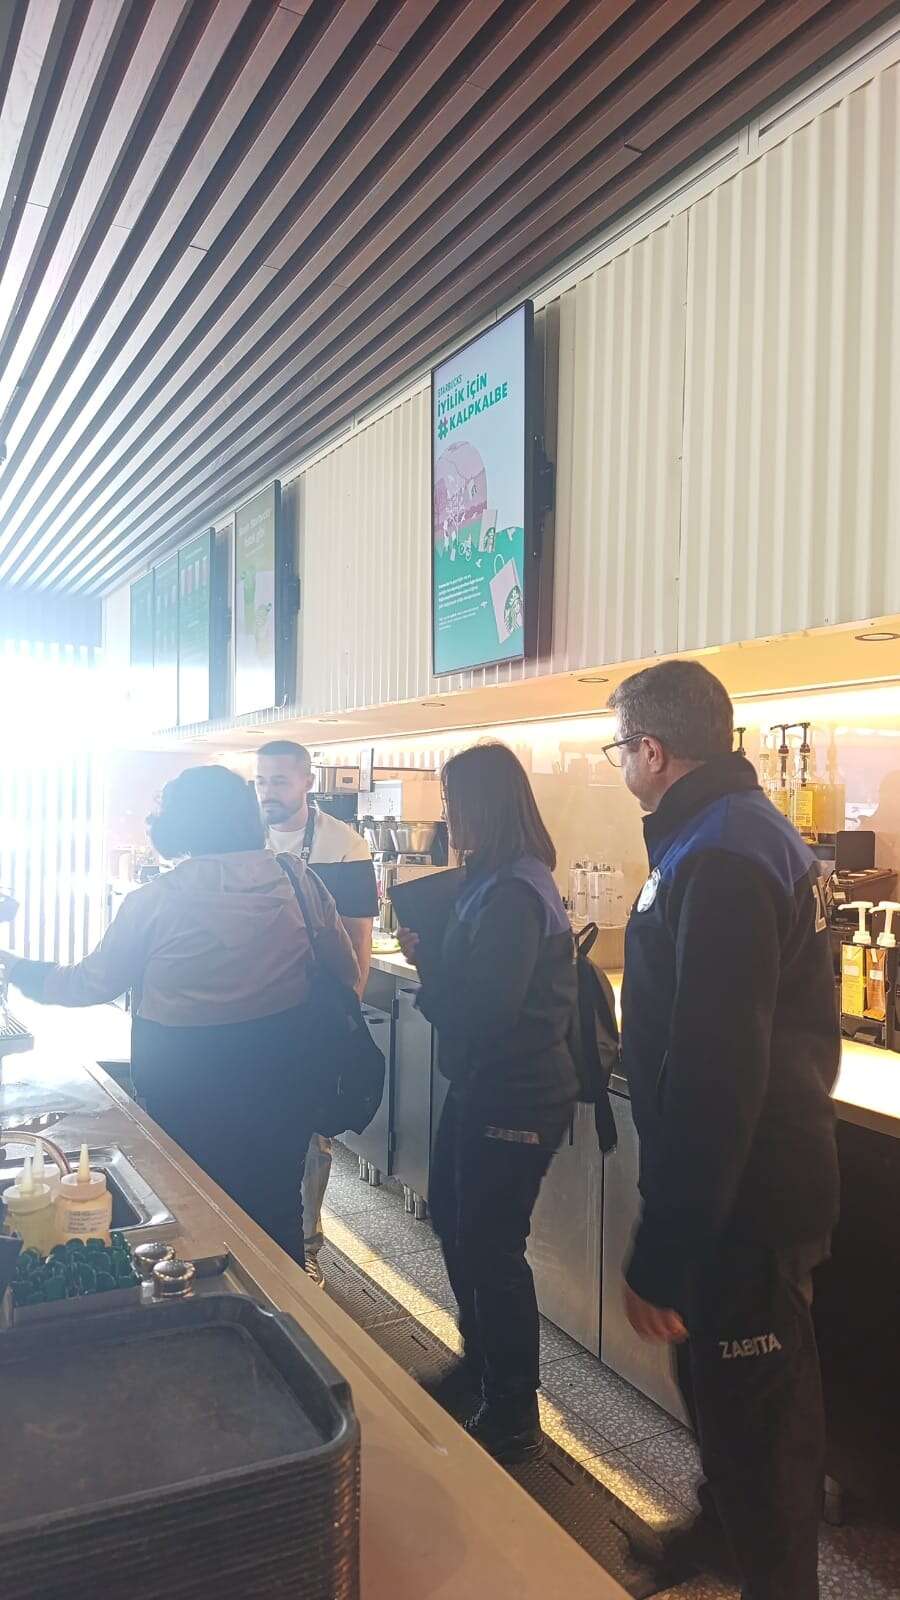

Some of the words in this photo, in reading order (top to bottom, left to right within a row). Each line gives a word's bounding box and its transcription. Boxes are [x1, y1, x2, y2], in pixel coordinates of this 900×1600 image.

[438, 388, 464, 417] İYİLİK
[467, 372, 487, 399] İÇİN
[438, 382, 508, 440] #KALPKALBE
[719, 1333, 782, 1359] ZABITA
